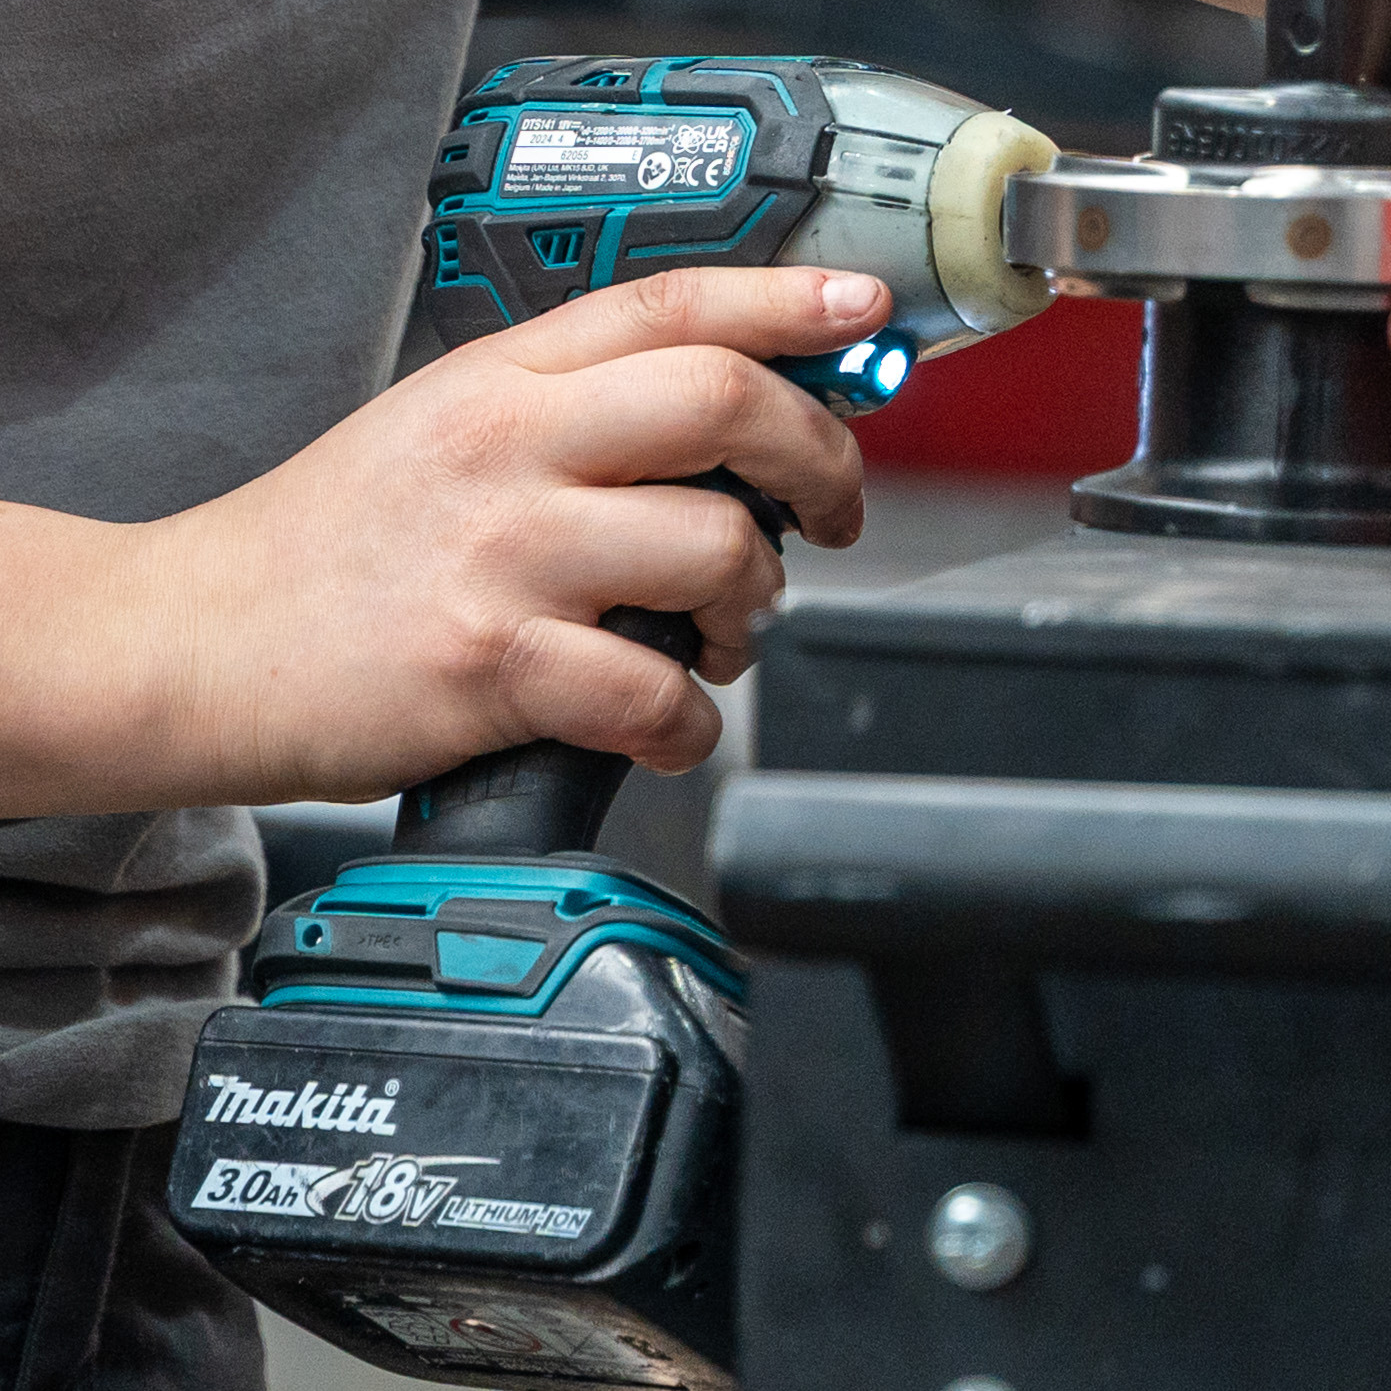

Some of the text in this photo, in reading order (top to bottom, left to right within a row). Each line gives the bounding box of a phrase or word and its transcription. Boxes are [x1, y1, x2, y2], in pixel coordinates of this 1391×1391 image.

[521, 118, 556, 130] DTS141
[529, 134, 552, 144] 2024
[706, 125, 730, 140] UK
[702, 139, 728, 153] CA
[560, 150, 589, 161] 62055
[207, 1168, 299, 1208] 3.0Ah
[335, 1153, 457, 1226] 18V
